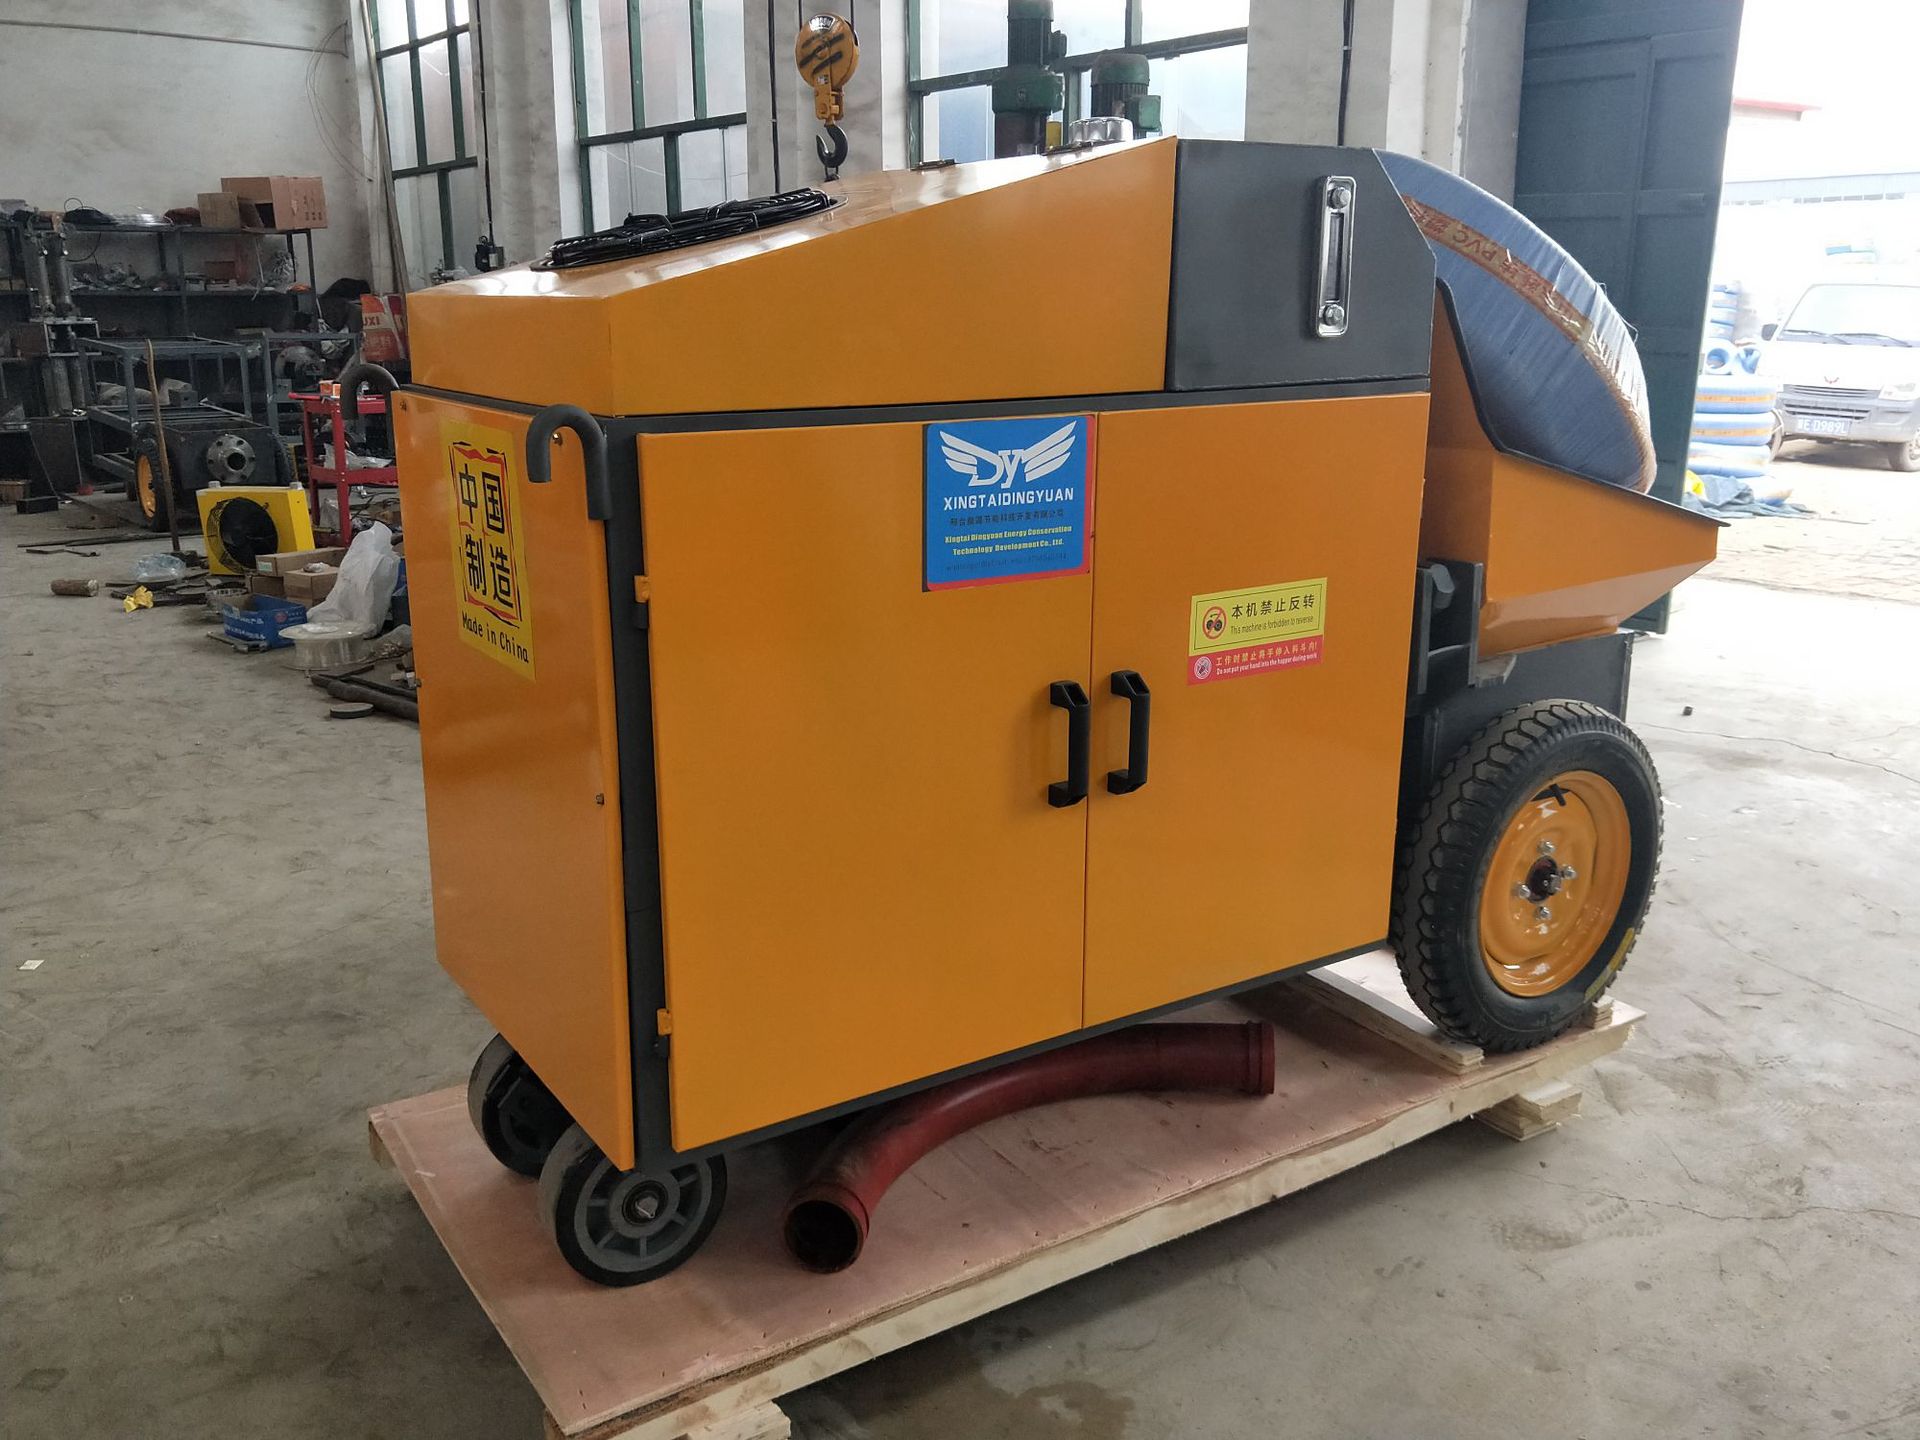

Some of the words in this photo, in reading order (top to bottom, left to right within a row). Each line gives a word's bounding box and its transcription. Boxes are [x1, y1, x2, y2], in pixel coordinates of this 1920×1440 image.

[1452, 229, 1498, 262] PVC
[459, 463, 505, 534] 中国
[944, 488, 1074, 511] XINGTAIDINGYUAN
[944, 534, 970, 544] Xingtai
[970, 531, 1003, 542] Dingyuan
[1004, 529, 1027, 539] Energy
[1027, 526, 1072, 536] Conservation
[952, 545, 994, 556] Technology
[994, 541, 1039, 552] Development
[465, 533, 514, 609] 制造
[1231, 594, 1315, 619] 本机禁止反转
[462, 610, 483, 637] Made
[486, 622, 497, 645] in
[500, 631, 529, 663] China
[1231, 625, 1241, 634] This
[1242, 622, 1262, 633] machine
[1267, 617, 1290, 629] forbidden
